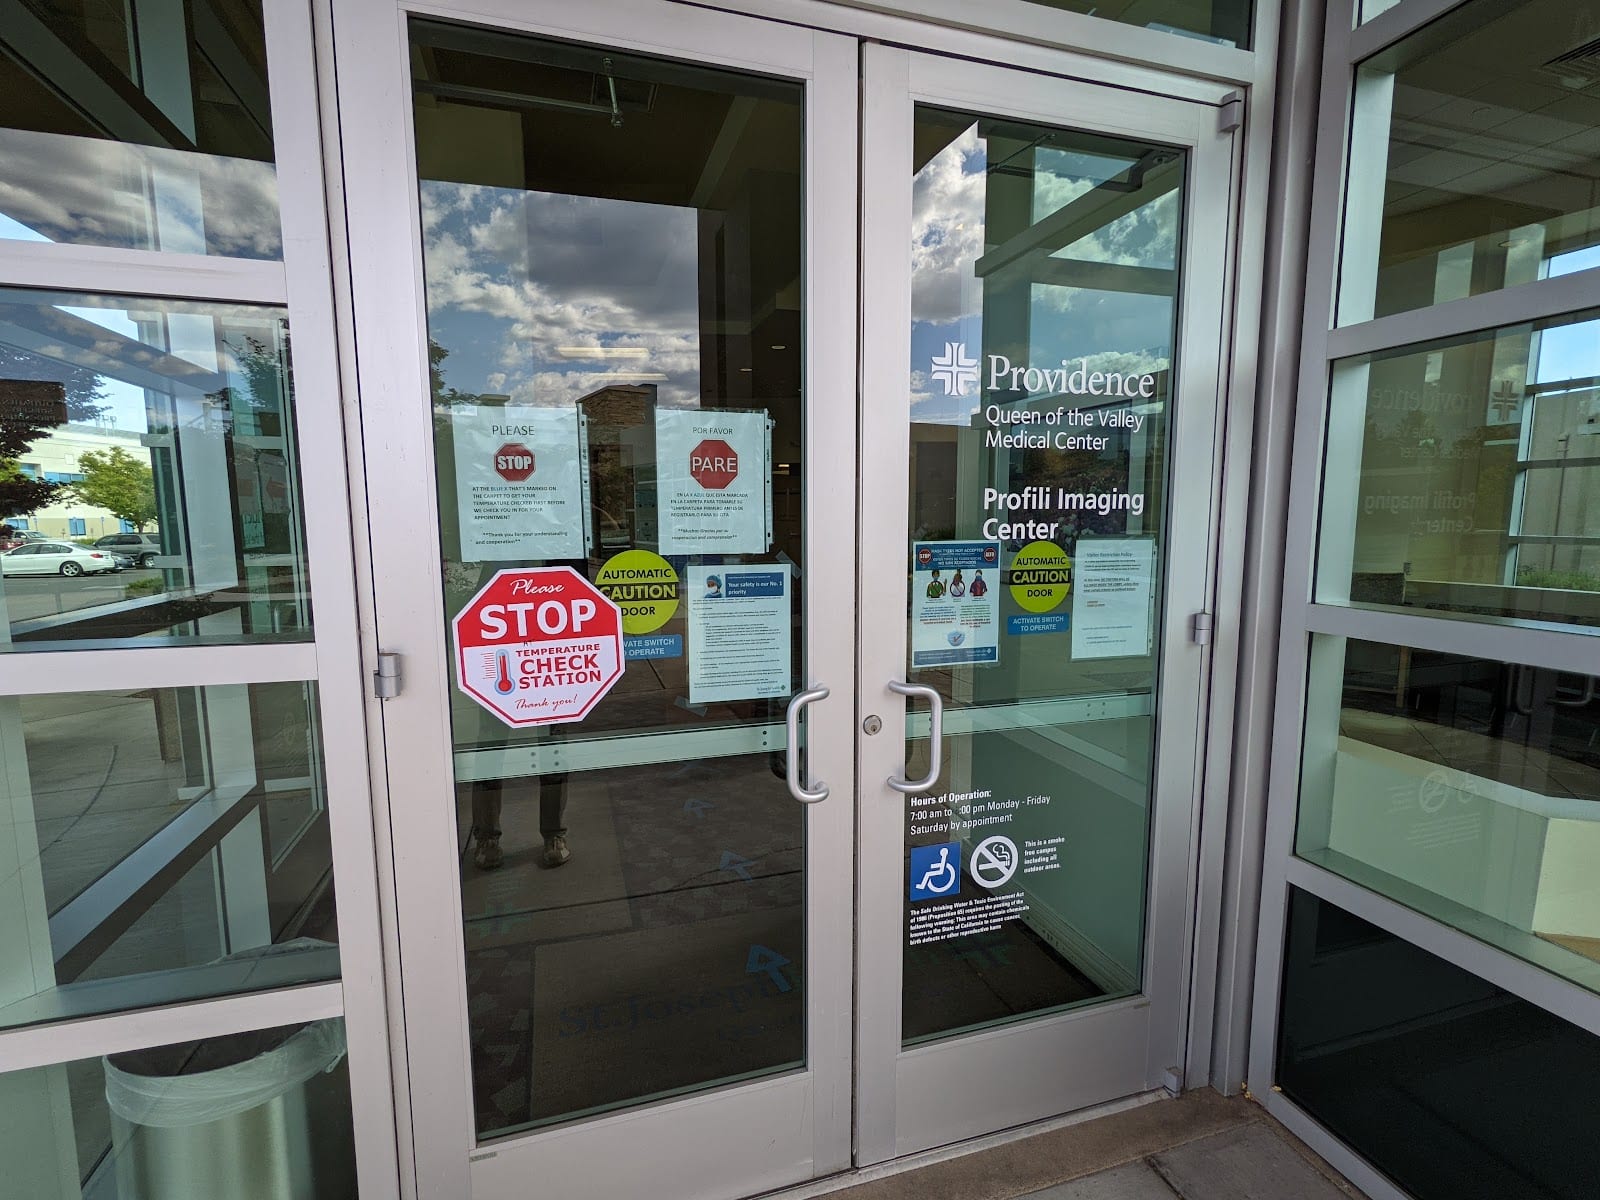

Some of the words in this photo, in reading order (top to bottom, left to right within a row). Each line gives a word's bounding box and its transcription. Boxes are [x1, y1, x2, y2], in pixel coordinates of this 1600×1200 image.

[987, 354, 1154, 397] Providence
[985, 405, 1041, 426] Queen
[1045, 407, 1064, 425] of
[1068, 408, 1093, 426] the
[1098, 410, 1144, 432] Valley
[492, 425, 535, 436] PLEASE
[985, 430, 1050, 449] Medical
[1055, 432, 1109, 450] Center
[497, 456, 532, 470] STOP
[692, 457, 737, 472] PARE
[984, 487, 1050, 510] Profili
[1058, 488, 1144, 515] Imaging
[983, 519, 1059, 540] Center
[1016, 557, 1066, 566] AUTOMATIC
[602, 568, 672, 579] AUTOMATIC
[1012, 570, 1069, 584] CAUTION
[510, 578, 564, 596] Please
[600, 584, 676, 600] CAUTION
[1027, 589, 1052, 598] DOOR
[622, 606, 656, 616] DOOR
[479, 598, 596, 640] STOP
[644, 638, 674, 646] SWITCH
[516, 644, 600, 658] TEMPERATURE
[628, 648, 665, 656] OPERATE
[520, 654, 599, 674] CHECK
[519, 670, 601, 690] STATION
[515, 698, 548, 710] Thank
[552, 694, 578, 712] you!
[910, 796, 936, 807] Hours
[938, 794, 948, 804] of
[948, 790, 992, 802] Operation:
[910, 810, 928, 820] 7:00
[944, 808, 952, 816] to
[972, 804, 986, 815] pm
[987, 800, 1020, 812] Monday
[1026, 795, 1050, 806] Friday
[910, 823, 948, 835] Saturday
[950, 820, 960, 831] by
[962, 814, 1013, 829] appointment
[1024, 856, 1048, 864] including
[1024, 866, 1044, 874] outdoor
[932, 904, 954, 912] Drinking
[965, 906, 984, 914] requires
[993, 902, 1010, 910] posting
[910, 922, 934, 930] following
[1006, 904, 1030, 913] chemicals
[960, 920, 984, 928] California
[910, 938, 922, 946] birth
[922, 936, 940, 944] defects
[960, 927, 990, 936] reproductive
